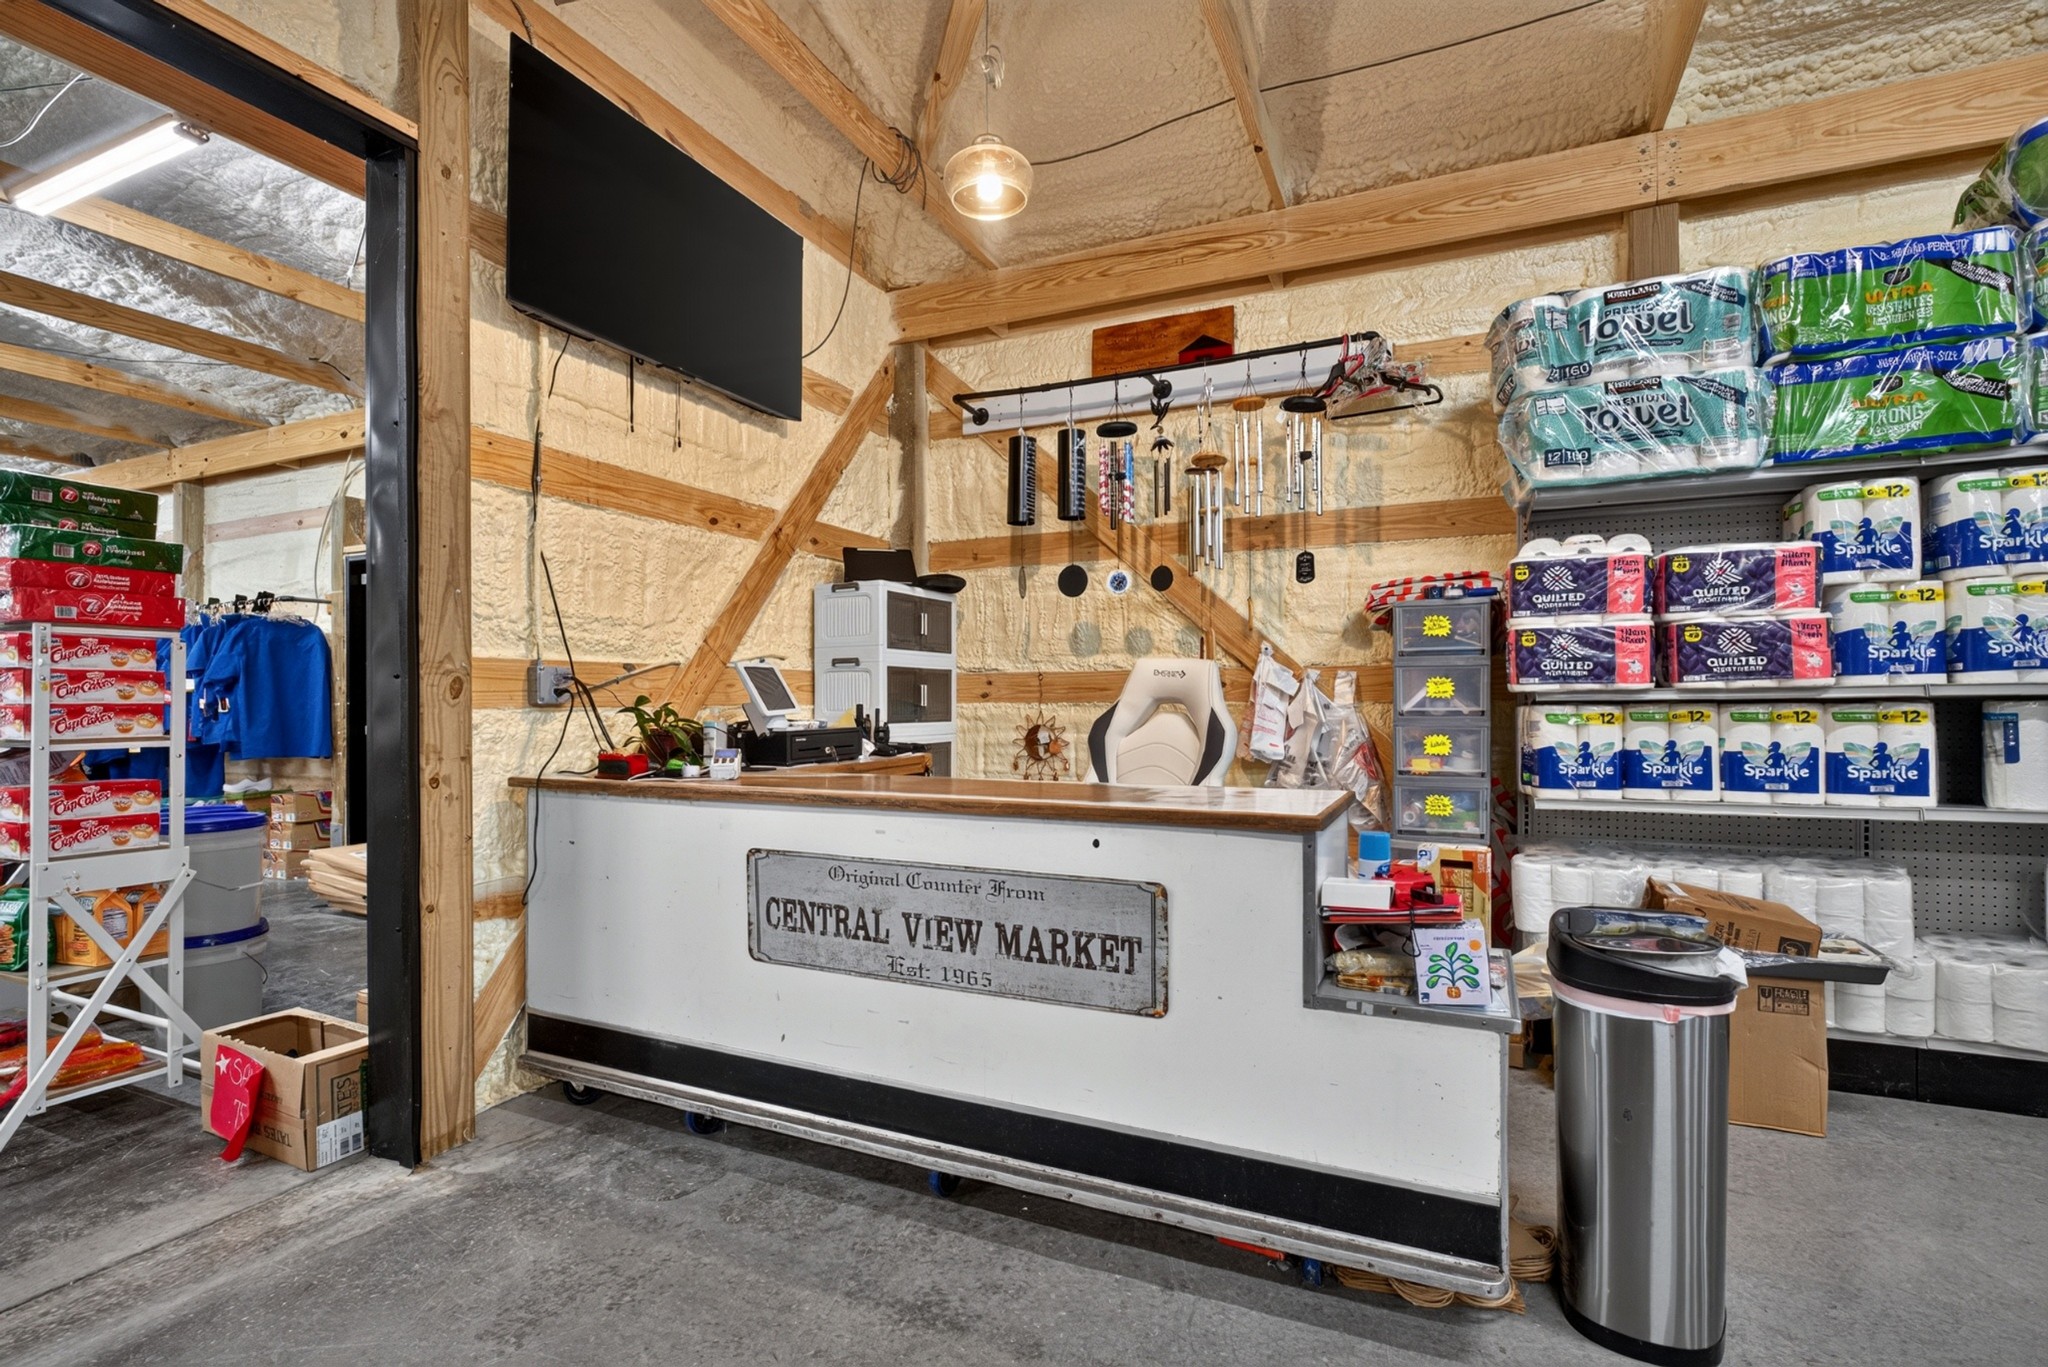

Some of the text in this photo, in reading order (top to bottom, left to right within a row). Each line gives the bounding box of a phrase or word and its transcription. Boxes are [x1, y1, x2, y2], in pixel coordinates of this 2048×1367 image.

[1865, 281, 1933, 304] ULTRA
[1578, 301, 1694, 346] Towel
[1580, 395, 1692, 433] Towel
[1885, 484, 1904, 497] 12
[1834, 541, 1901, 558] Sparkle
[1532, 592, 1586, 603] QUILTED
[1693, 586, 1751, 598] QUILTED
[1917, 588, 1935, 601] 12
[1868, 644, 1936, 661] Sparkle
[1541, 661, 1593, 671] QUILTED
[1707, 656, 1767, 667] QUILTED
[1600, 712, 1615, 724] 12
[1688, 711, 1705, 722] 12
[1793, 710, 1811, 723] 12
[1902, 710, 1921, 723] 12
[1559, 762, 1615, 778] Sparkle
[1643, 761, 1704, 778] Sparkle
[1744, 764, 1810, 781] Sparkle
[1847, 765, 1919, 782] Sparkle
[828, 865, 1046, 903] Original Counter From
[766, 896, 1142, 975] CENTRAL VIEW MARKET
[942, 966, 993, 988] 1965
[1774, 988, 1808, 1000] FRAGILE
